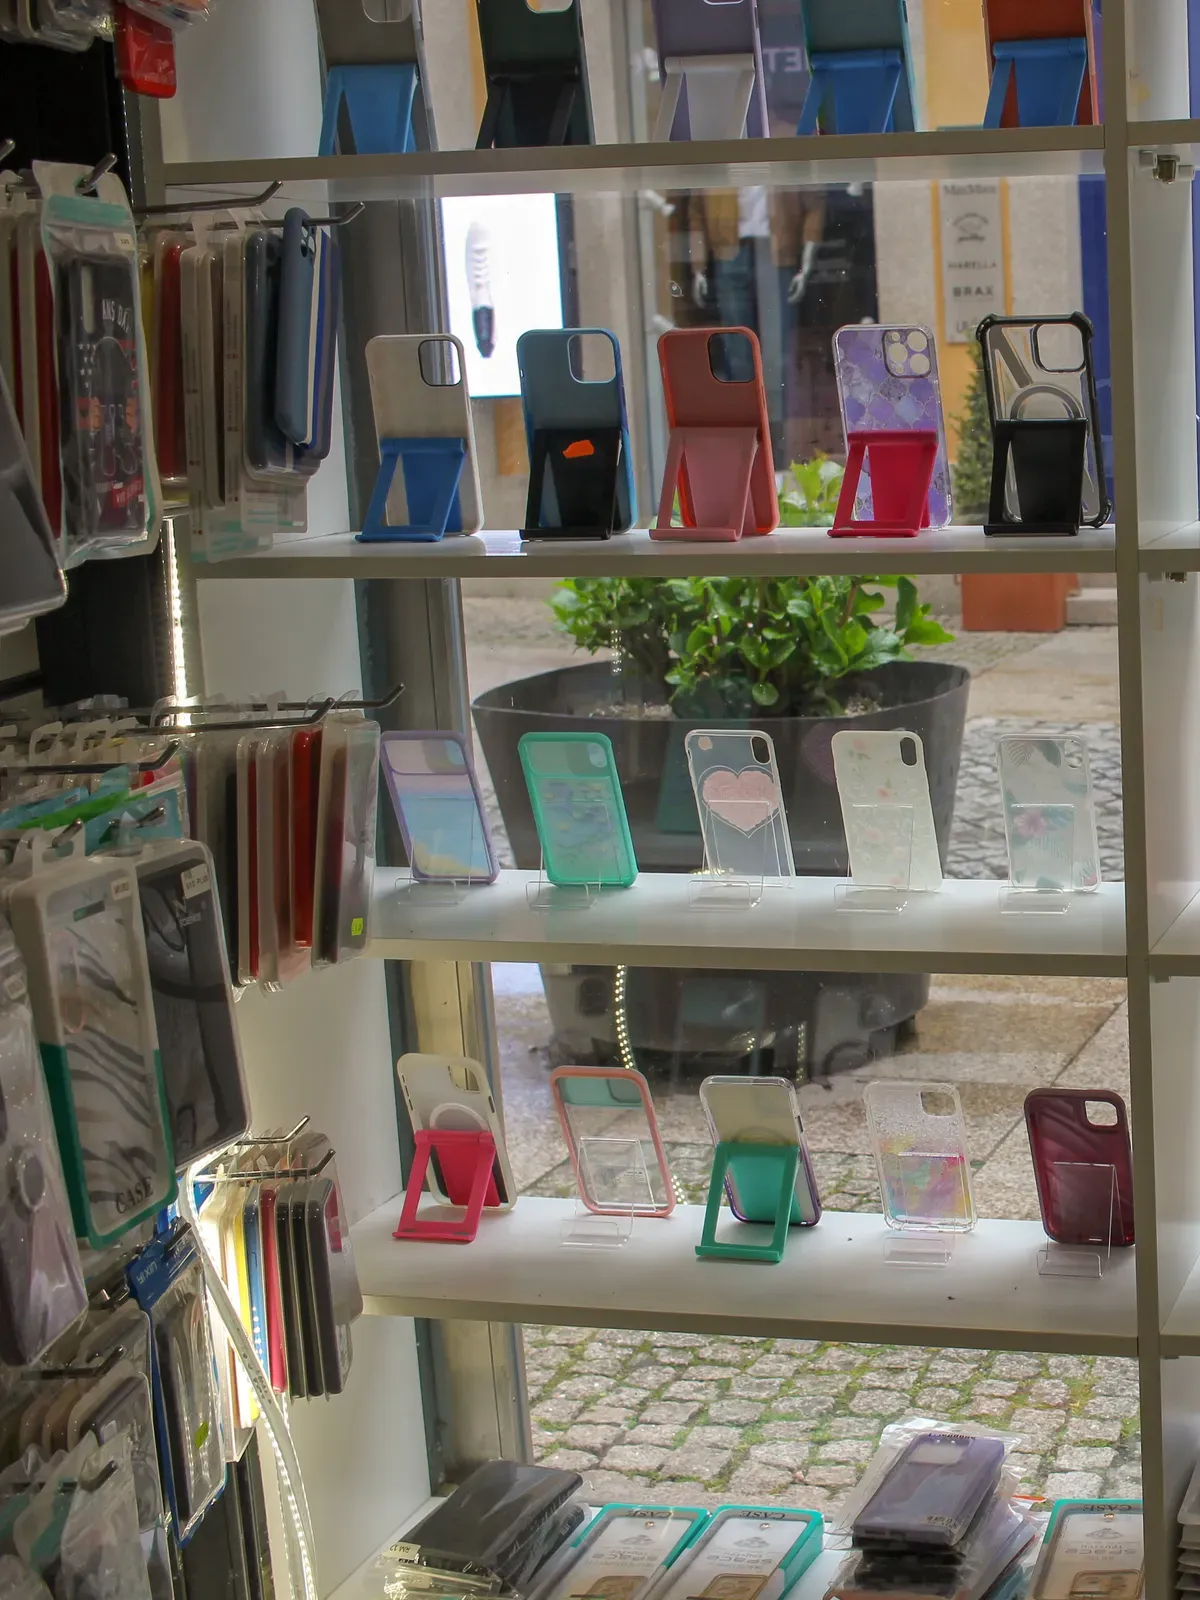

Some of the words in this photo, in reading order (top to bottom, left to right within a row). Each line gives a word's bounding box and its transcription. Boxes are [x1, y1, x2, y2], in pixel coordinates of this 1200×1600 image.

[953, 286, 994, 298] BRAX
[116, 1176, 155, 1214] CASE
[626, 1509, 673, 1519] CASE
[738, 1510, 786, 1520] CASE
